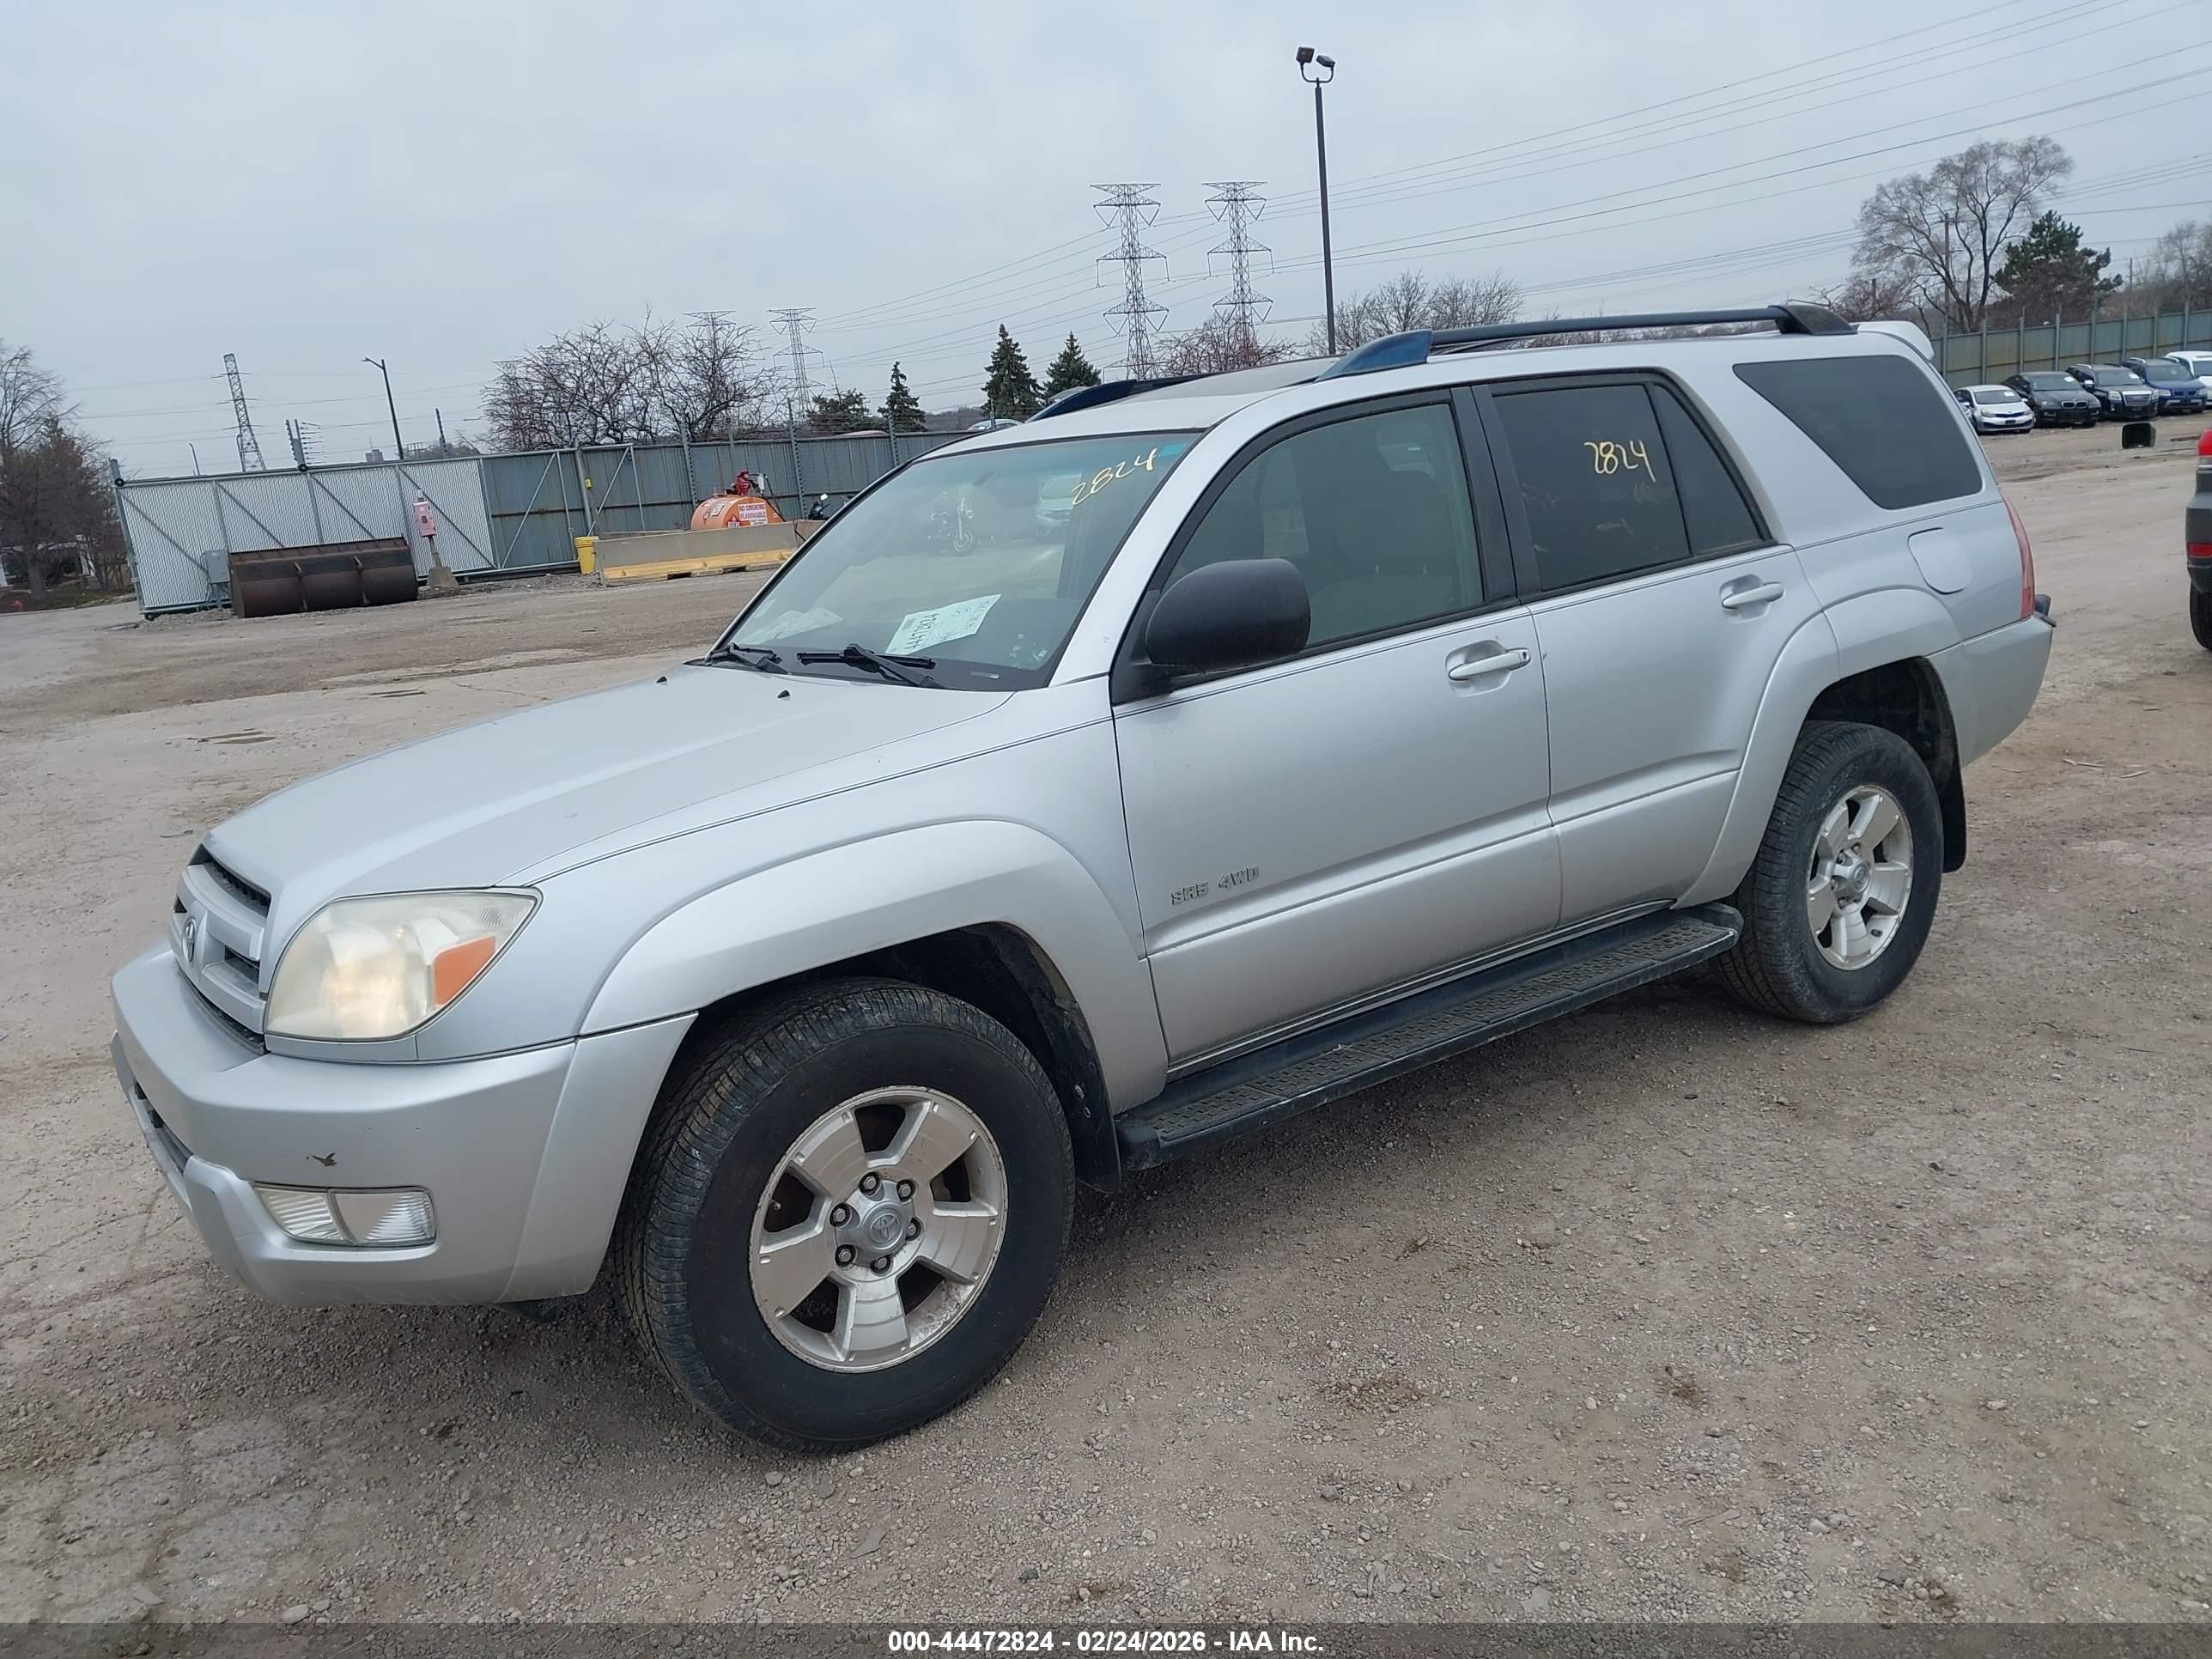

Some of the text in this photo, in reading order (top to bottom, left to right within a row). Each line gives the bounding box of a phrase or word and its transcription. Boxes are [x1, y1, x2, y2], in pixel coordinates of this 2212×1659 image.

[1071, 447, 1158, 506] 2824
[1583, 439, 1656, 483] 2824
[1170, 865, 1260, 906] SR5 4WD
